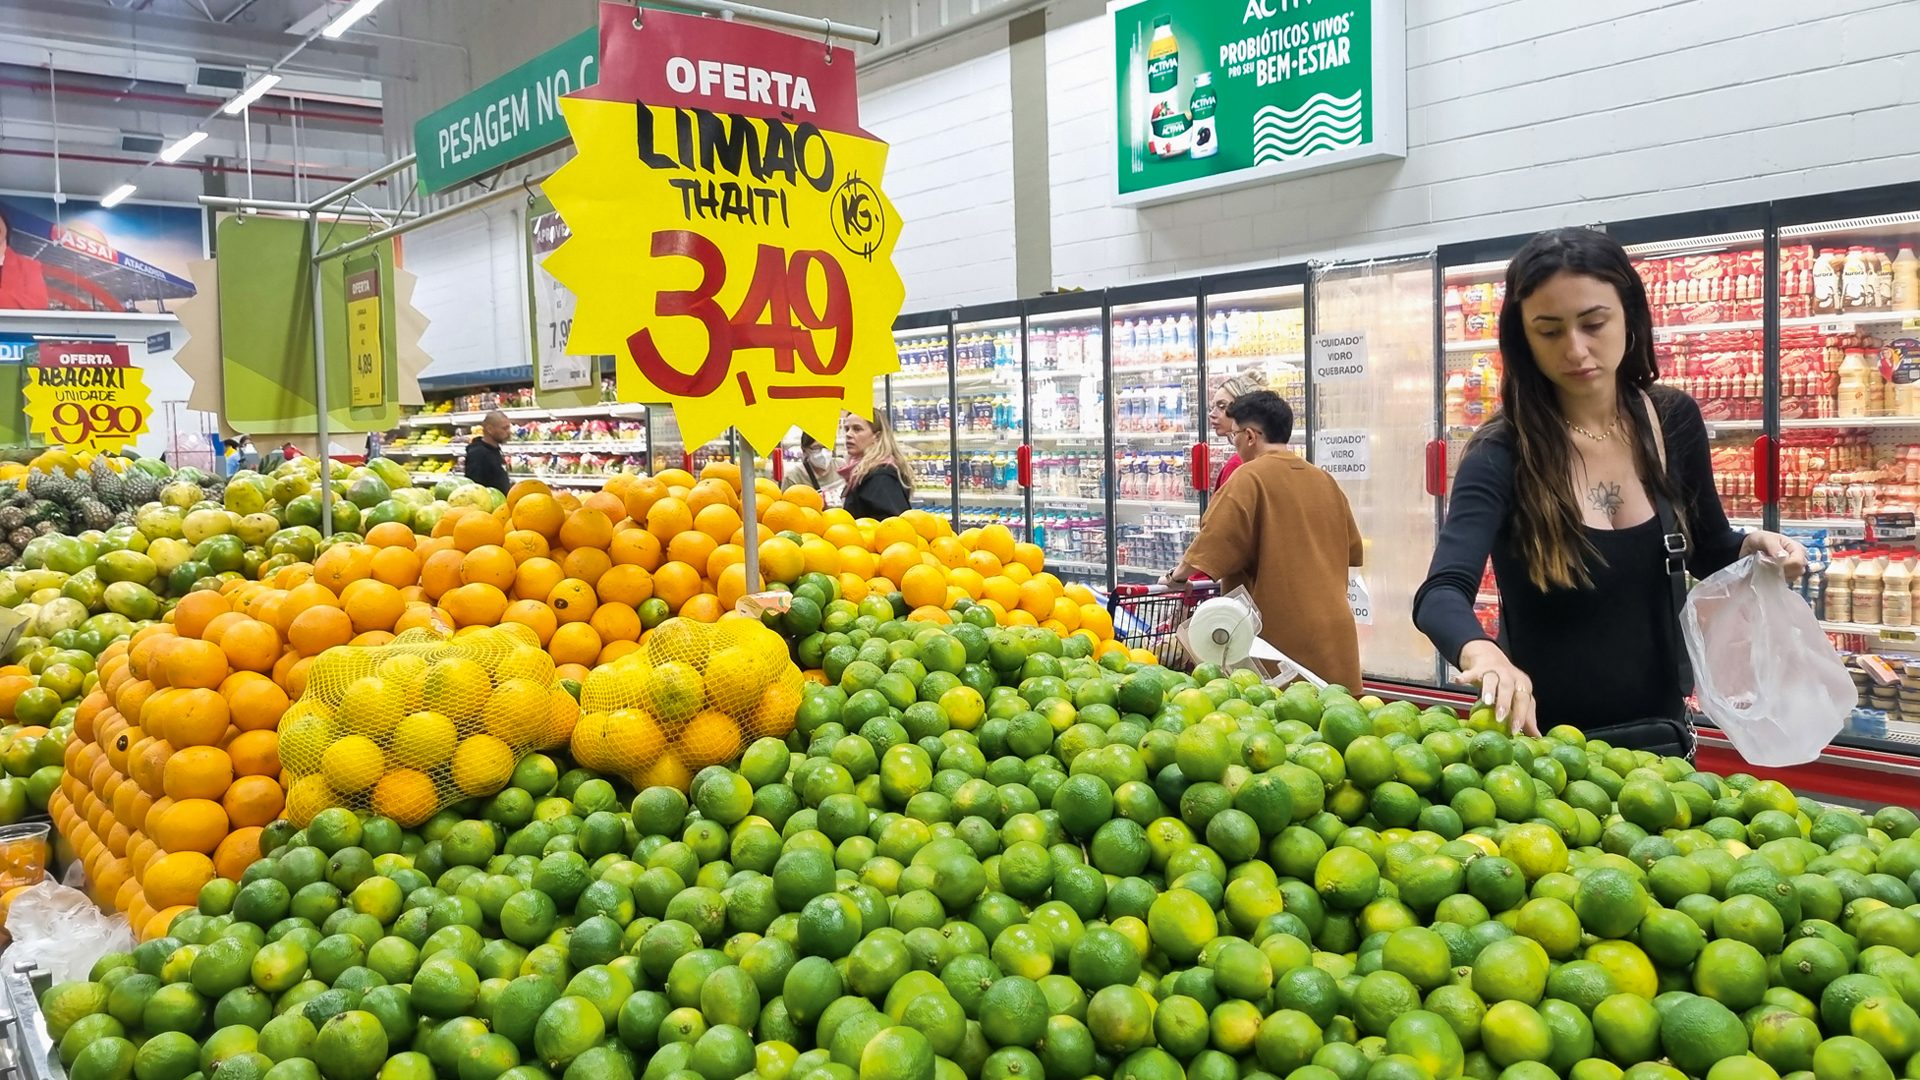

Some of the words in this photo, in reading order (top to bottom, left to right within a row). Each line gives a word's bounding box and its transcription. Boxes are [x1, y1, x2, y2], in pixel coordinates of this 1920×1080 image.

[1220, 21, 1310, 67] PROBIÓTICOS
[1148, 57, 1178, 74] ACTIVIA
[1228, 66, 1242, 78] PRO
[1242, 61, 1255, 75] SEU
[665, 57, 816, 113] OFERTA
[1191, 96, 1216, 109] ACTIVIA
[438, 88, 530, 169] PESAGEM
[536, 68, 571, 126] NO
[636, 98, 834, 193] LIMÃO
[668, 179, 790, 228] THAITI
[626, 229, 853, 406] 3,49
[59, 354, 113, 365] OFERTA
[1327, 351, 1353, 361] VIDRO
[38, 367, 125, 389] ABACAXI
[1318, 364, 1364, 377] QUEBRADO
[55, 390, 117, 401] UNIDADE
[50, 403, 142, 449] 9,90
[1330, 449, 1355, 459] VIDRO
[1321, 463, 1366, 473] QUEBRADO
